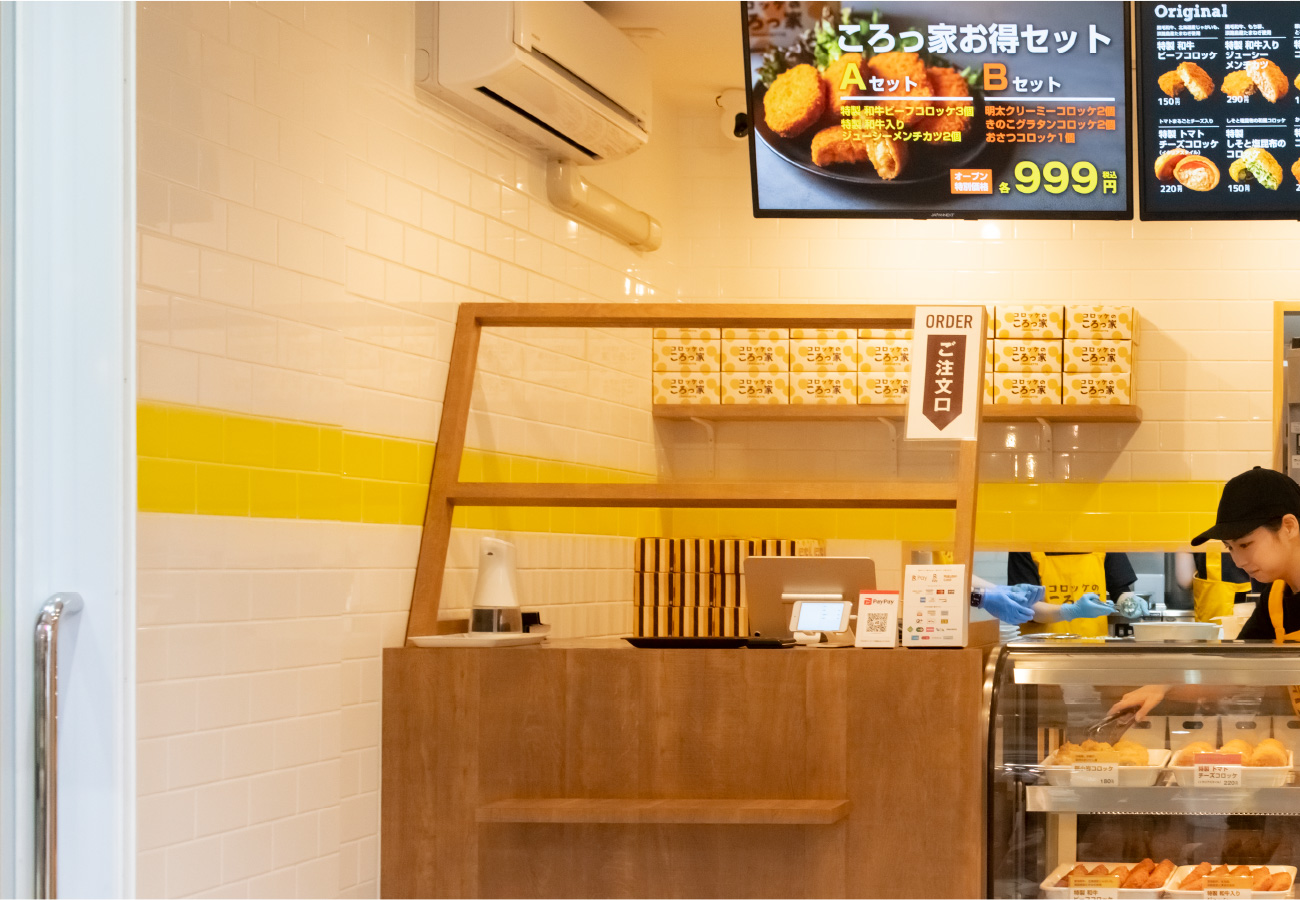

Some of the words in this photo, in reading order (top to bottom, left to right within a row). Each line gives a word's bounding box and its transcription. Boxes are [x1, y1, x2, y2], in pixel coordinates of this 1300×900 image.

[1155, 4, 1228, 22] Original
[838, 23, 1111, 54] ころっ家お得セット
[1177, 41, 1195, 51] 和牛
[1245, 40, 1279, 50] 和牛入り
[1158, 52, 1218, 60] ビーフコロッケ
[1225, 51, 1268, 59] ジューシー
[840, 106, 862, 117] 特製
[865, 106, 974, 117] 和牛ビーフコロッケ3個
[985, 106, 1115, 117] 明太クリーミーコロッケ2個
[841, 119, 862, 130] 特製
[865, 119, 904, 130] 和牛入り
[985, 119, 1116, 130] きのこグラタンコロッケ2個
[842, 131, 962, 143] ジューシーメンチカツ2個
[986, 132, 1075, 144] おさつコロッケ1個
[1180, 130, 1204, 138] トマト
[1159, 140, 1219, 148] チーズコロッケ
[955, 172, 988, 181] オープン
[926, 314, 972, 328] ORDER
[1013, 319, 1048, 328] ころっ家
[1082, 319, 1117, 329] ころっ家
[670, 353, 705, 362] ころっ家
[738, 353, 773, 362] ころっ家
[806, 353, 841, 362] ころっ家
[1012, 353, 1046, 362] ころっ家
[1081, 353, 1116, 363] ころっ家
[934, 340, 956, 412] ご注文口
[670, 385, 705, 394] ころっ家
[738, 385, 773, 394] ころっ家
[806, 385, 841, 394] ころっ家
[1011, 385, 1046, 394] ころっ家
[1080, 385, 1115, 395] ころっ家
[1049, 584, 1099, 592] コロッケの
